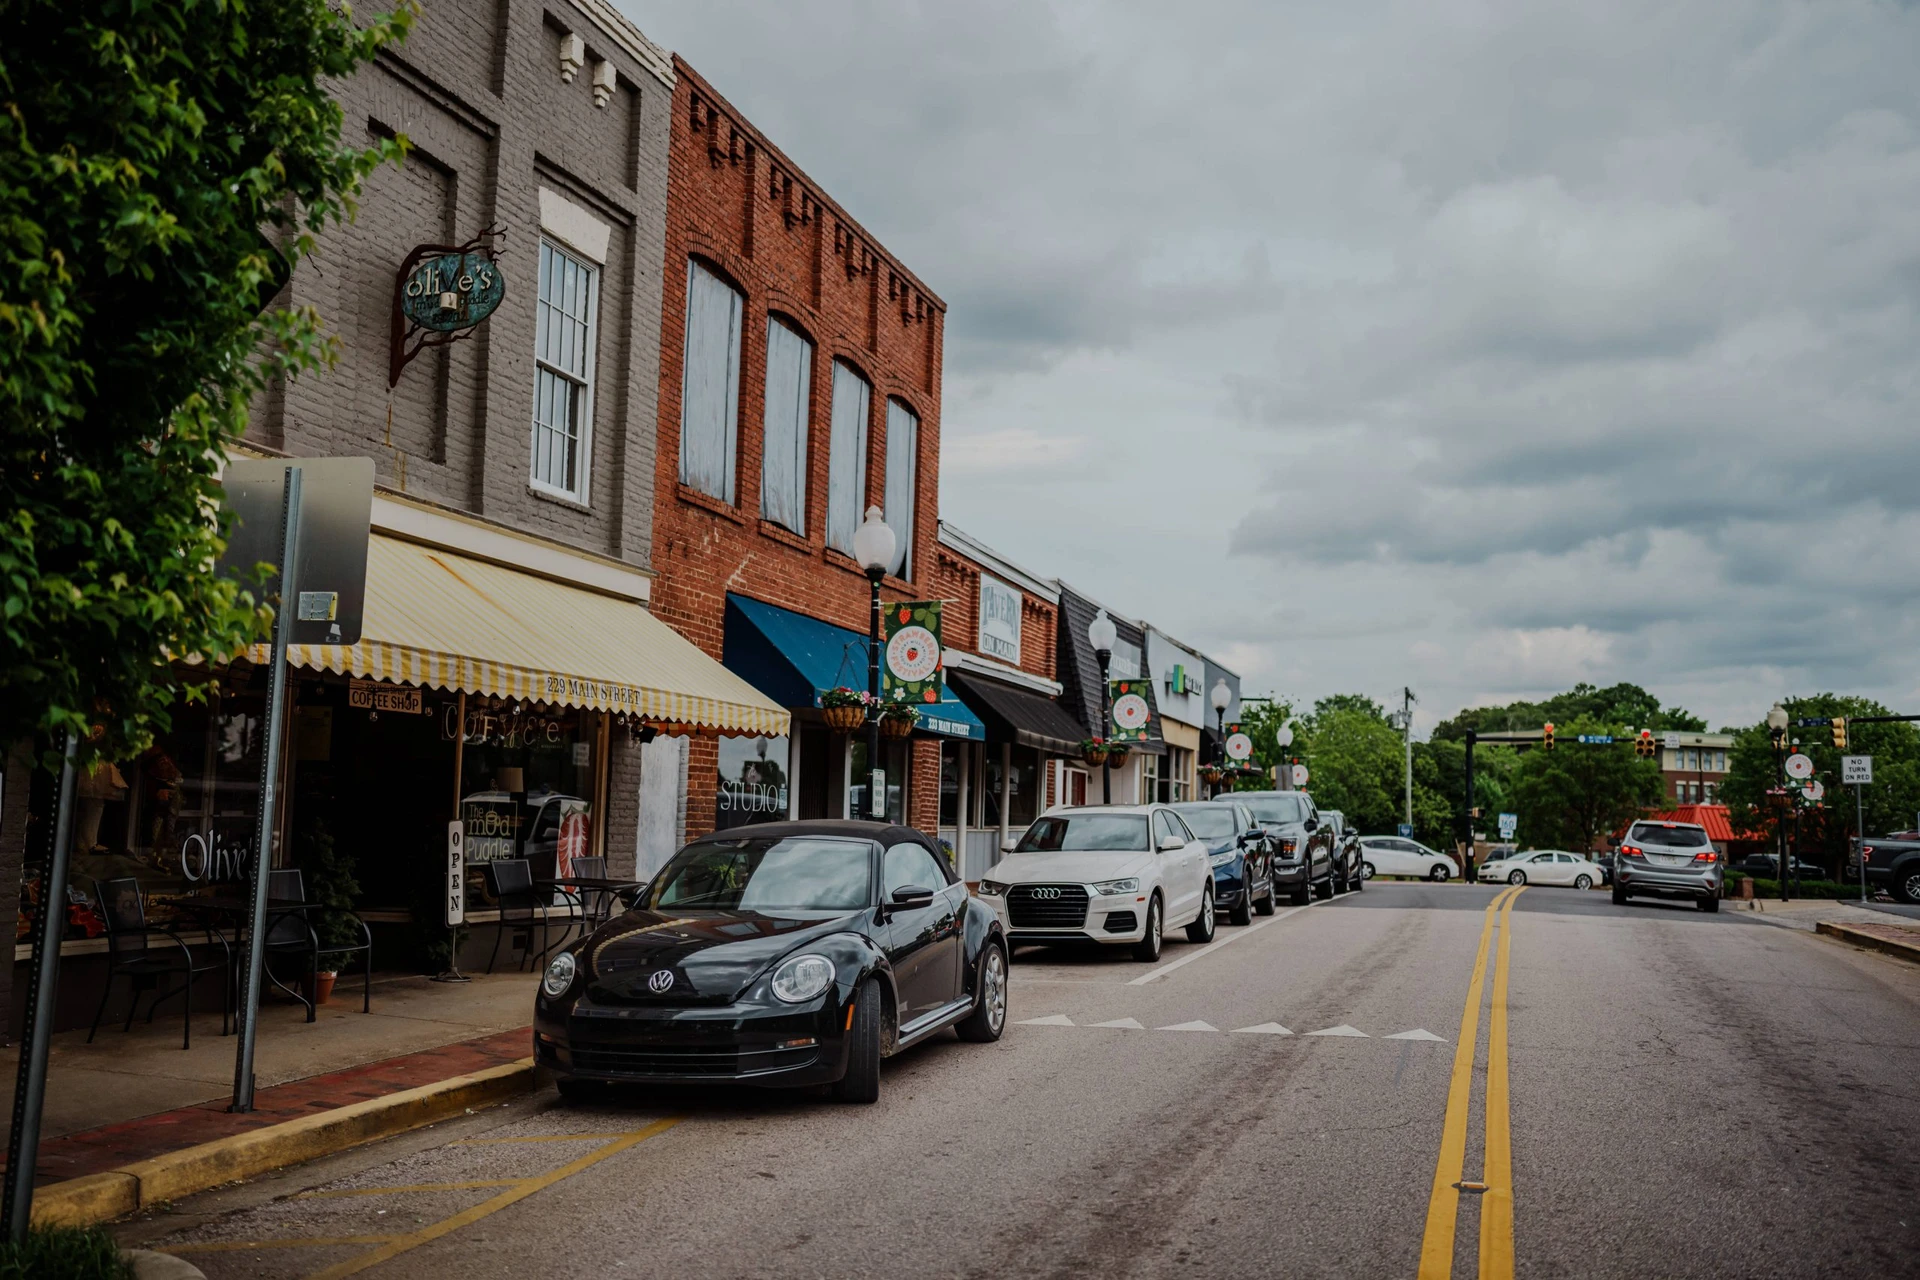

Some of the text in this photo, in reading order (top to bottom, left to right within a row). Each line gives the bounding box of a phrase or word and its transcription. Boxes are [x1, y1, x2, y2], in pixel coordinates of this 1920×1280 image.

[983, 587, 1019, 640] TAVERN
[892, 630, 936, 662] STRAWBERRY
[984, 633, 1017, 660] ON MAIN
[352, 690, 419, 711] COFFEE SHOP
[548, 677, 641, 704] 229 MAIN STREET
[938, 719, 951, 733] MAIN
[951, 722, 970, 736] STREET
[720, 780, 778, 813] STUDIO
[468, 811, 511, 837] mud
[469, 804, 485, 819] The
[1501, 819, 1514, 829] 160
[182, 828, 253, 882] Olive'
[467, 837, 510, 861] Puddle
[450, 832, 461, 912] OPEN
